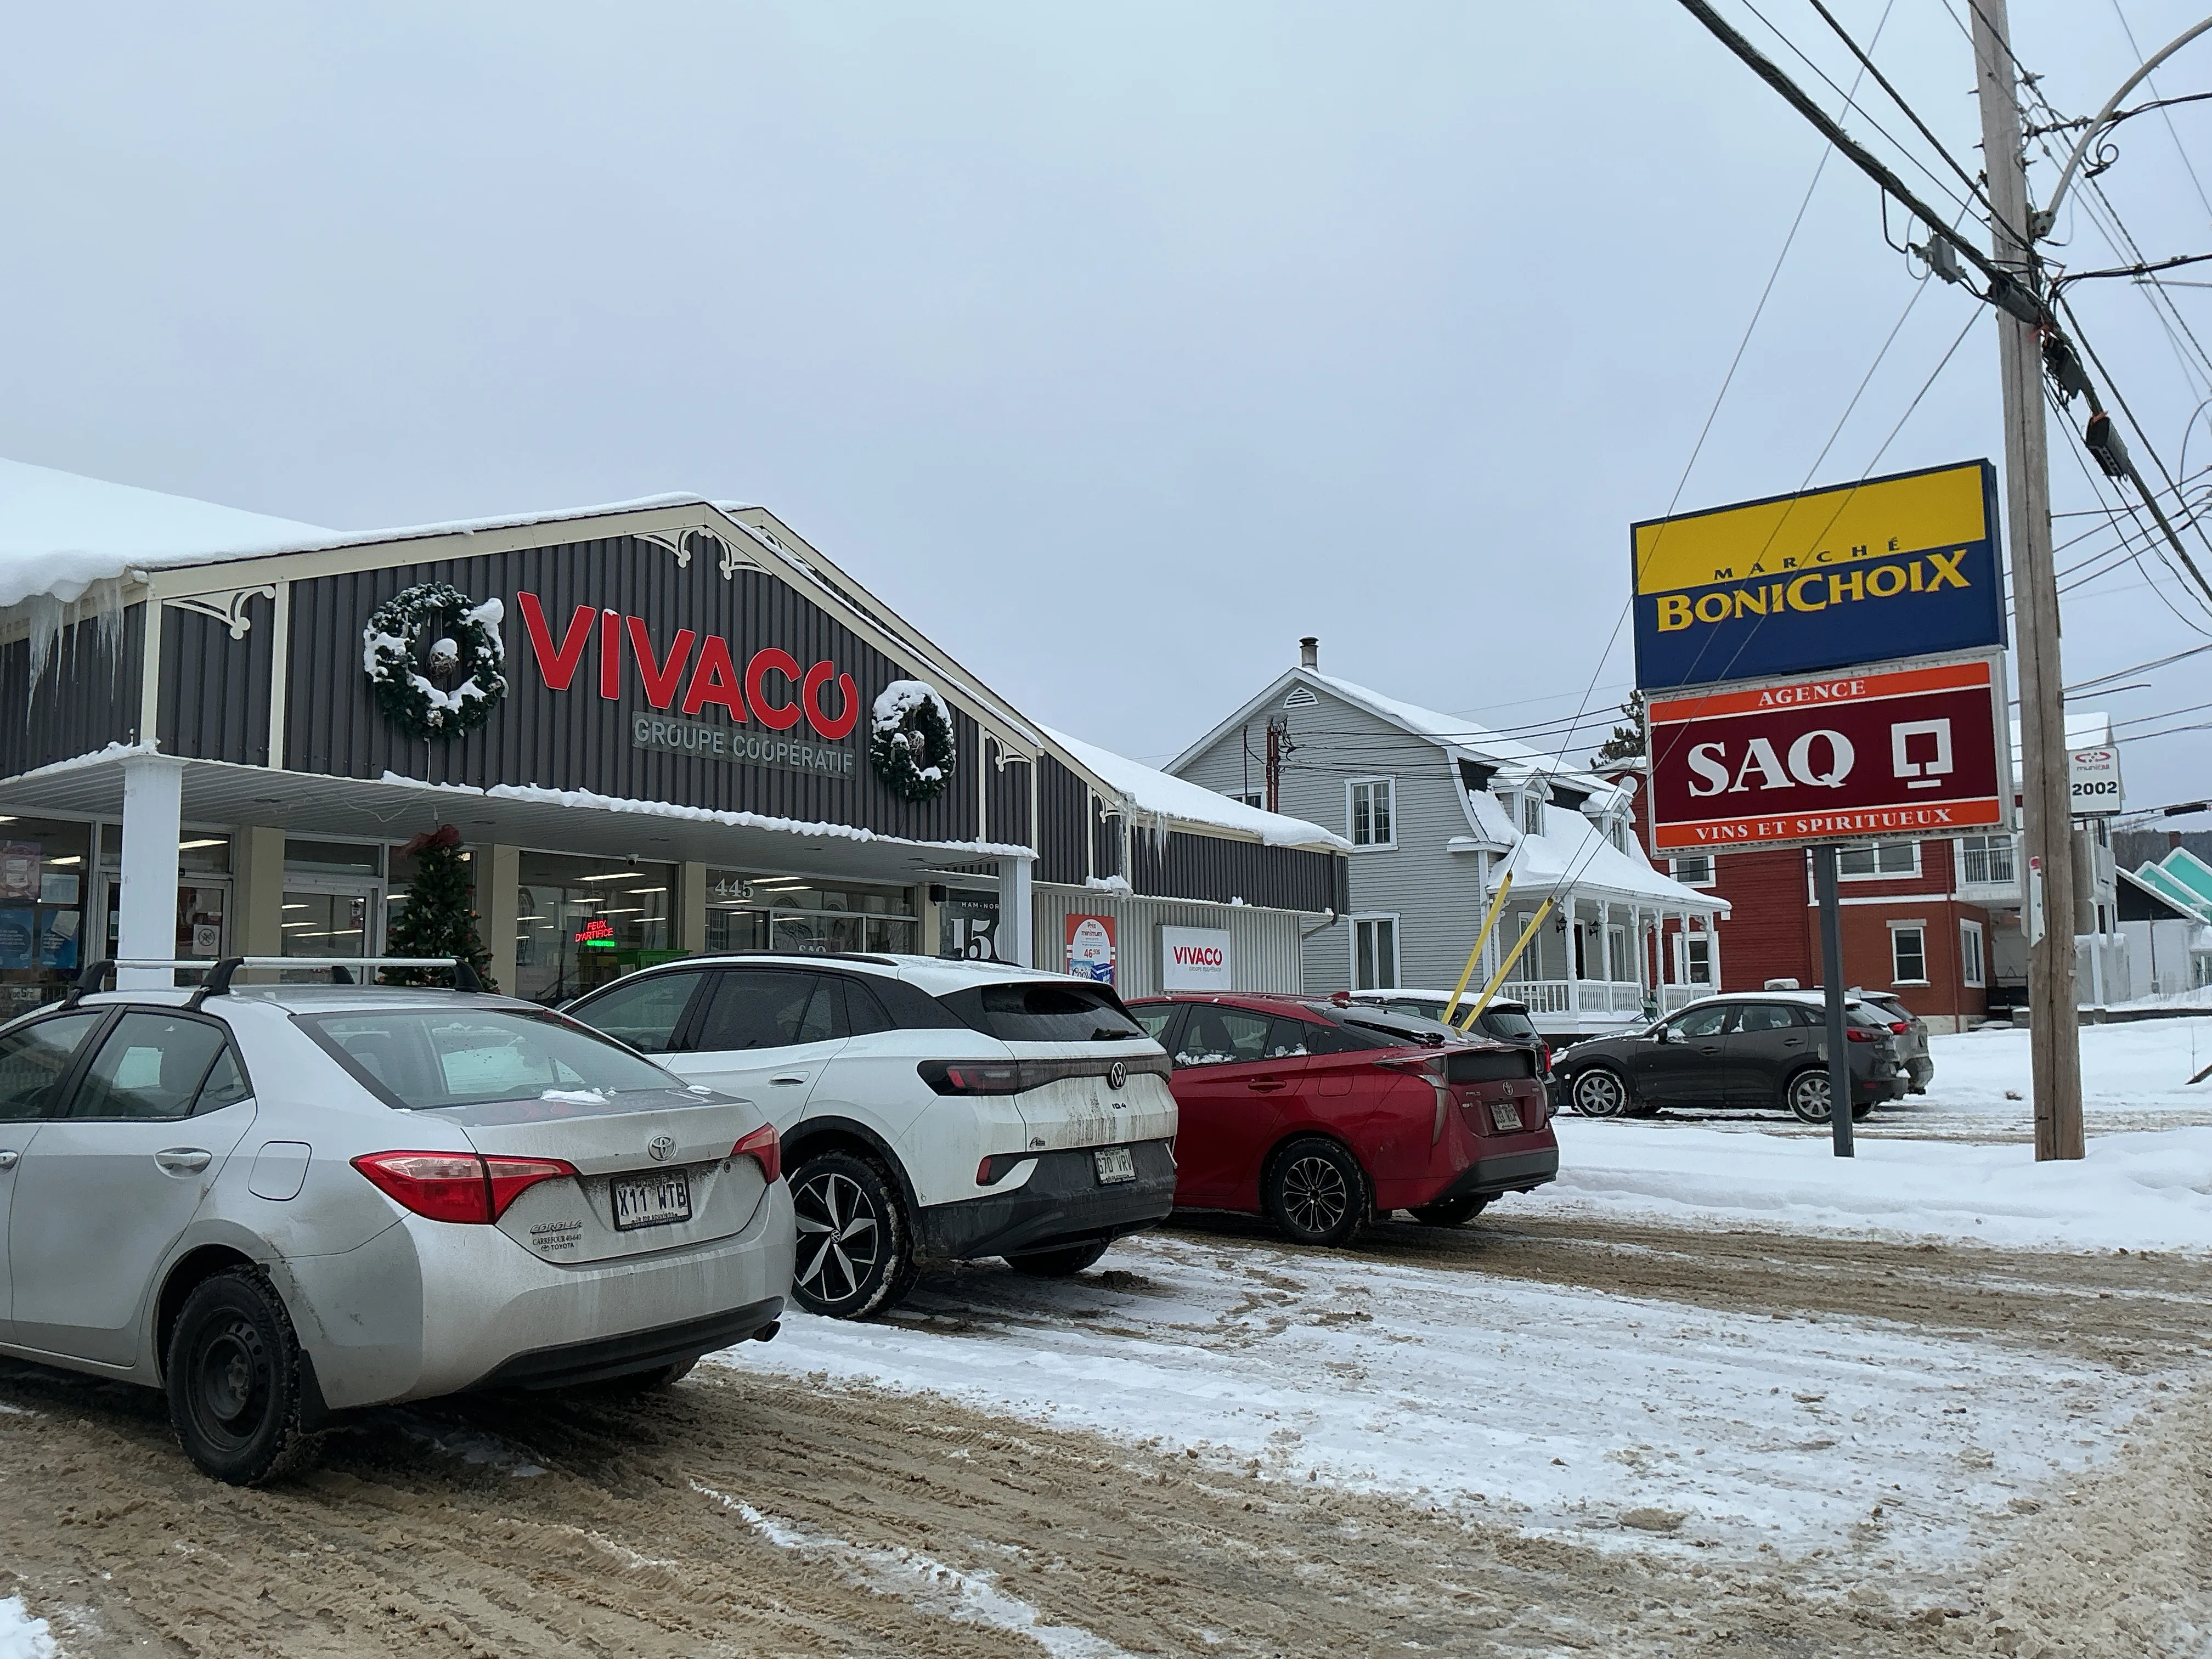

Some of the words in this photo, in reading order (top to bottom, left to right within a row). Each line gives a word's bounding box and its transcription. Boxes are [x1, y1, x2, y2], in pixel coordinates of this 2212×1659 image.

[1714, 537, 1899, 580] MARCHÉ
[517, 591, 859, 740] VIVACO
[1758, 680, 1866, 706] AGENCE
[635, 718, 724, 754] GROUPE
[733, 738, 853, 773] COOPÉRATIF
[1688, 730, 1855, 797] SAQ
[2072, 781, 2117, 795] 2002
[1695, 825, 1748, 840] VINS
[1758, 822, 1786, 837] ET
[1796, 808, 1953, 833] SPIRITUEUX
[715, 878, 754, 898] 445
[588, 920, 606, 930] FEUX
[951, 918, 1000, 960] 15
[1173, 946, 1222, 966] VIVACO
[1097, 1157, 1114, 1175] G70
[1116, 1154, 1132, 1171] VRV
[618, 1188, 646, 1216] X11
[657, 1182, 686, 1210] WTB
[533, 1235, 565, 1245] CARREFOUR
